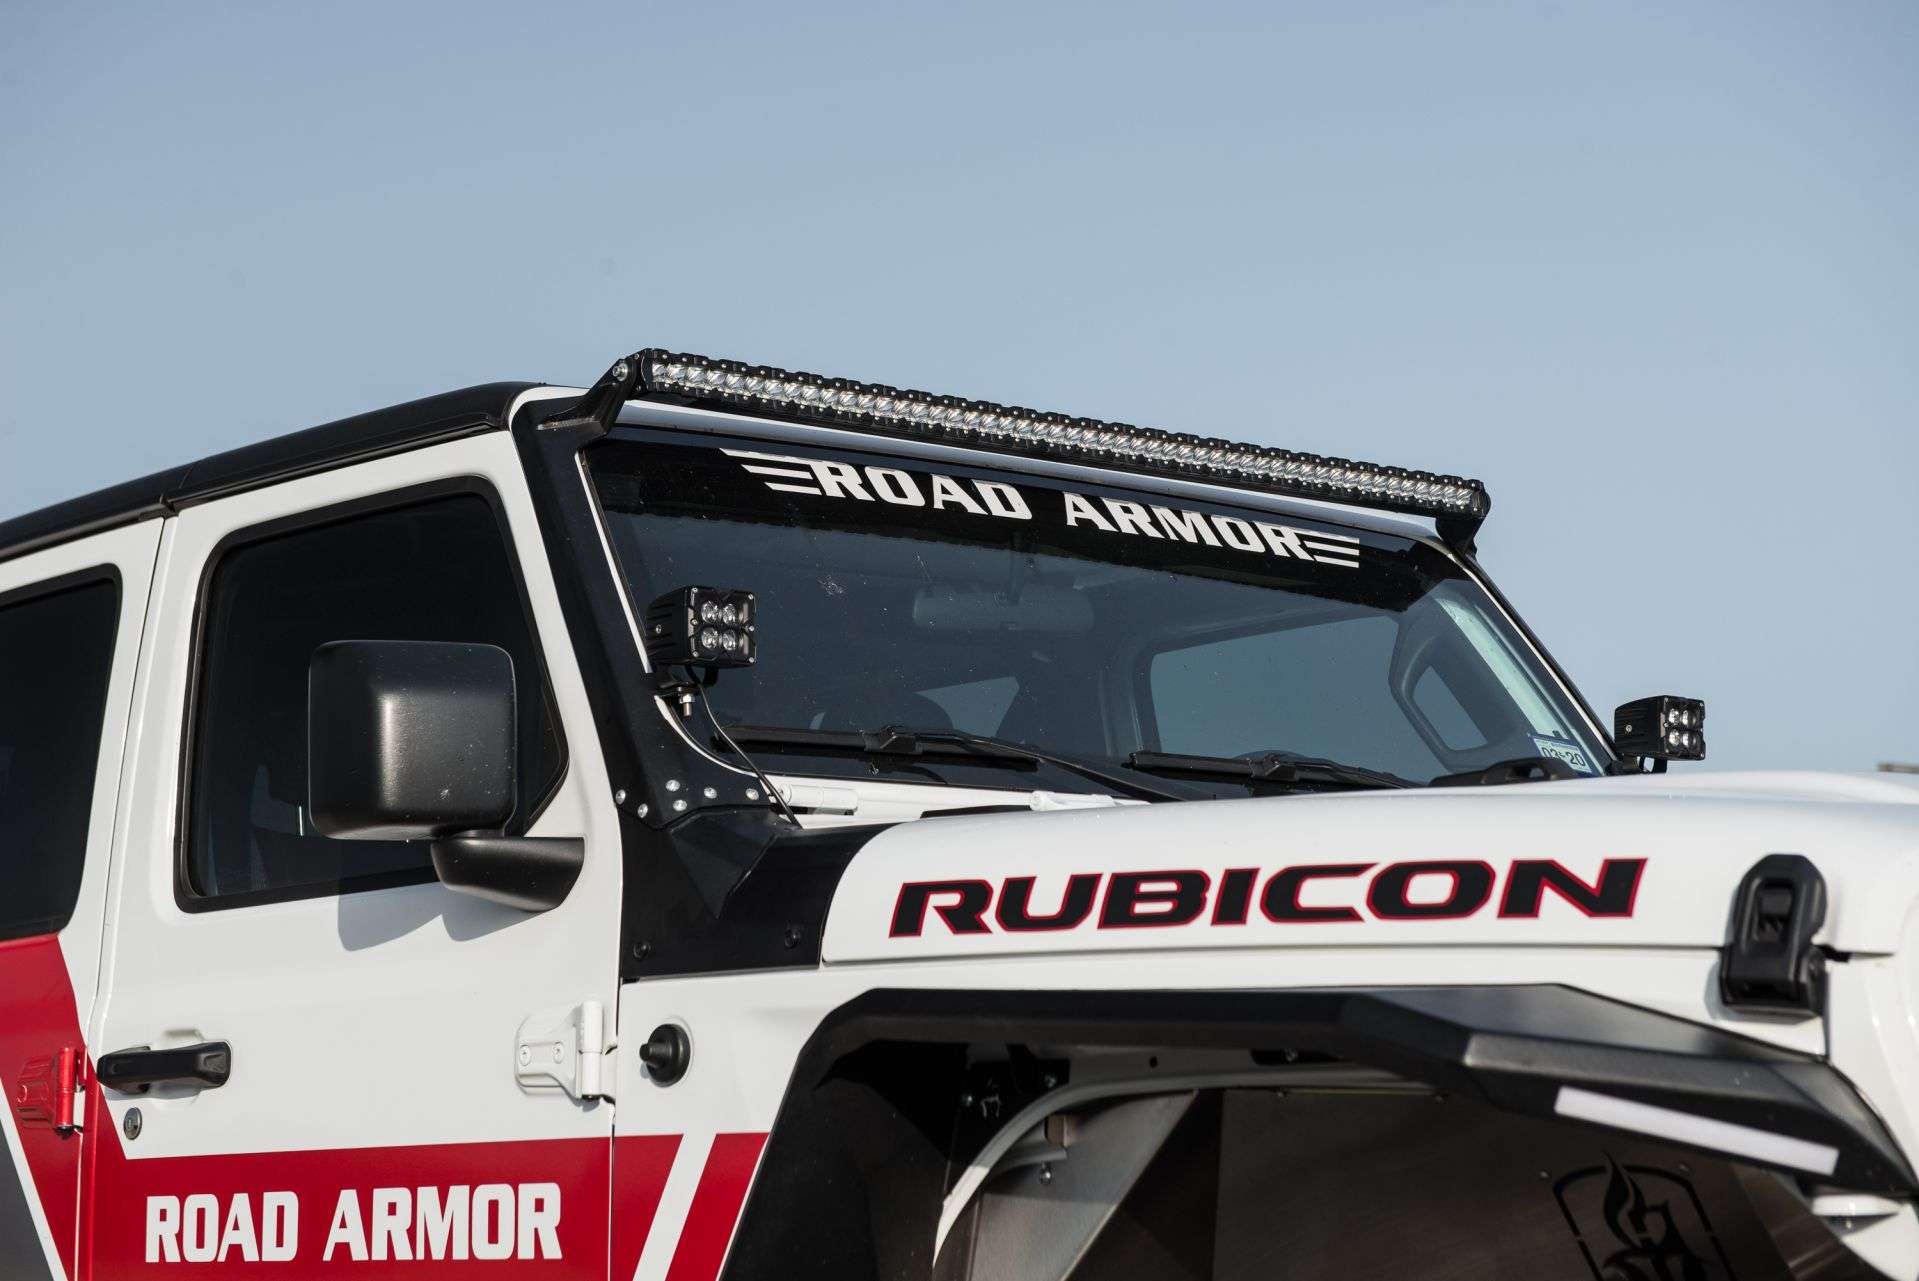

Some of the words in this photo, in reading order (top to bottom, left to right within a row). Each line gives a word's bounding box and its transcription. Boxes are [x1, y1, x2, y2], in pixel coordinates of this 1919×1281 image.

[810, 458, 1033, 520] ROAD
[1064, 492, 1316, 561] ARMOR
[889, 857, 1648, 939] RUBICON
[145, 1192, 299, 1263] ROAD
[322, 1182, 563, 1263] ARMOR
